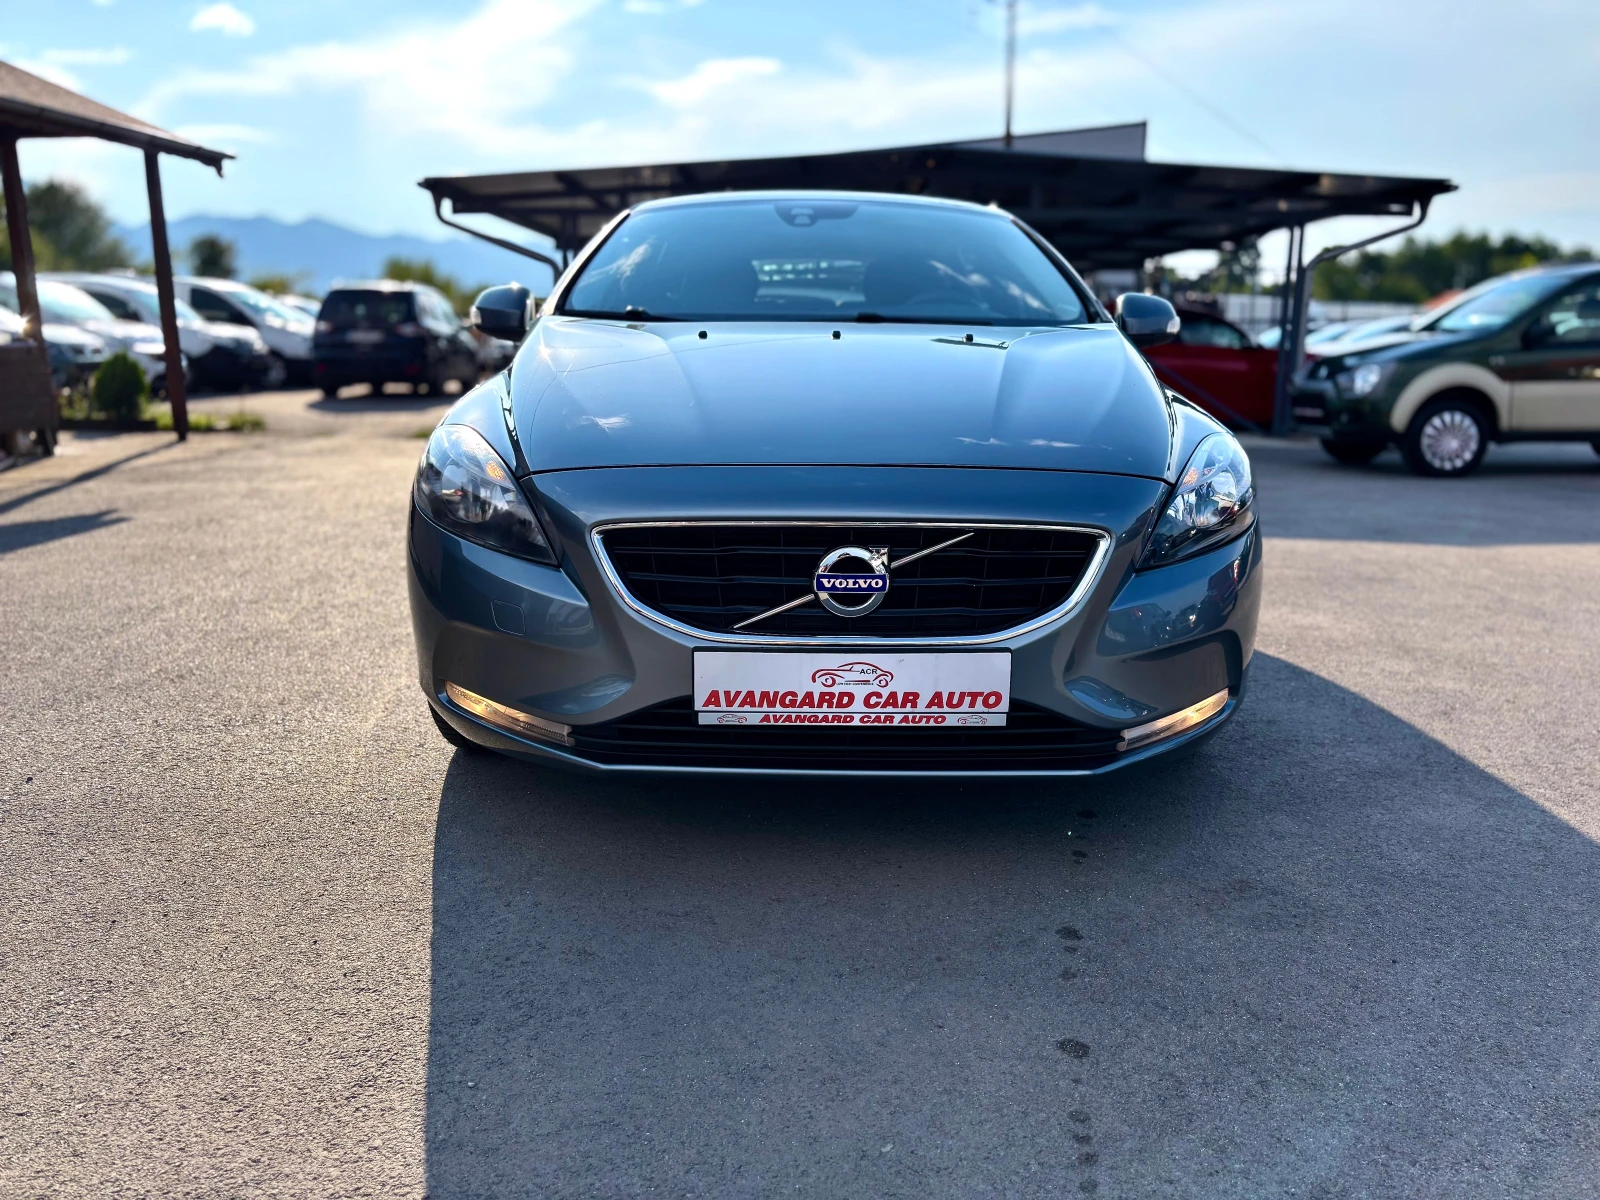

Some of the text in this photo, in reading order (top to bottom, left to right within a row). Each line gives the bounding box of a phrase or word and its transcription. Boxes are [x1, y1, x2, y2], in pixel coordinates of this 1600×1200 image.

[820, 578, 883, 588] VOLVO
[702, 690, 1003, 709] AVANGARD CAR AUTO
[759, 714, 947, 725] AVANGARD CAR AUTO
